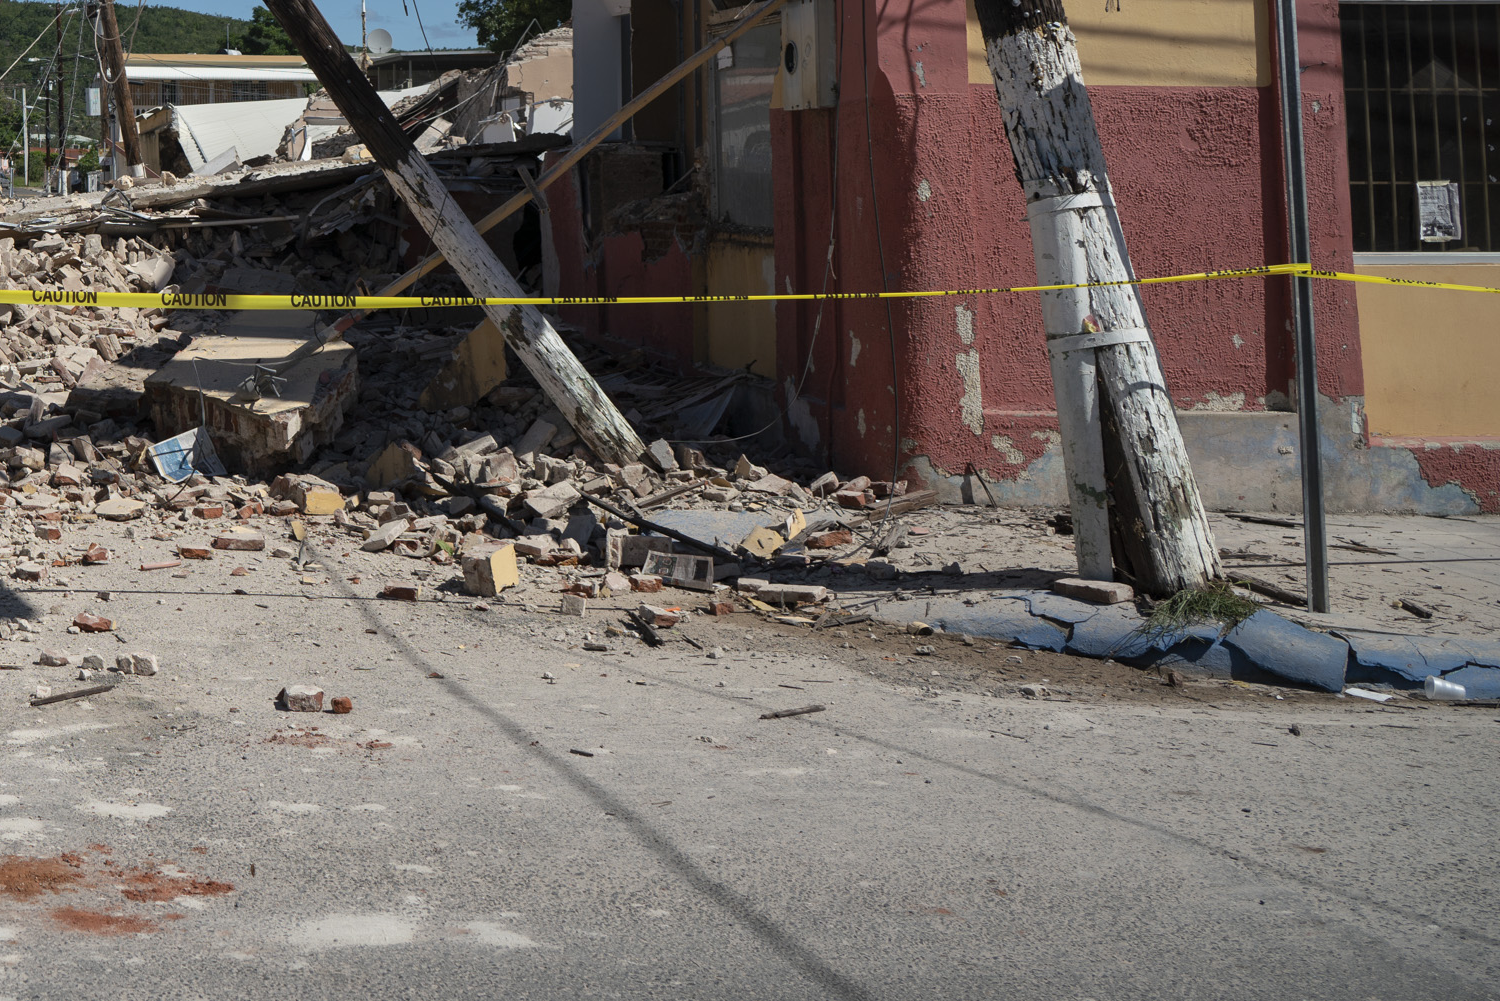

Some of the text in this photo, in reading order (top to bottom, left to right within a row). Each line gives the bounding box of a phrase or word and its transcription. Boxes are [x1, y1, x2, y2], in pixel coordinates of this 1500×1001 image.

[32, 290, 97, 304] CAUTION
[161, 293, 227, 307] CAUTION
[291, 294, 356, 307] CAUTION
